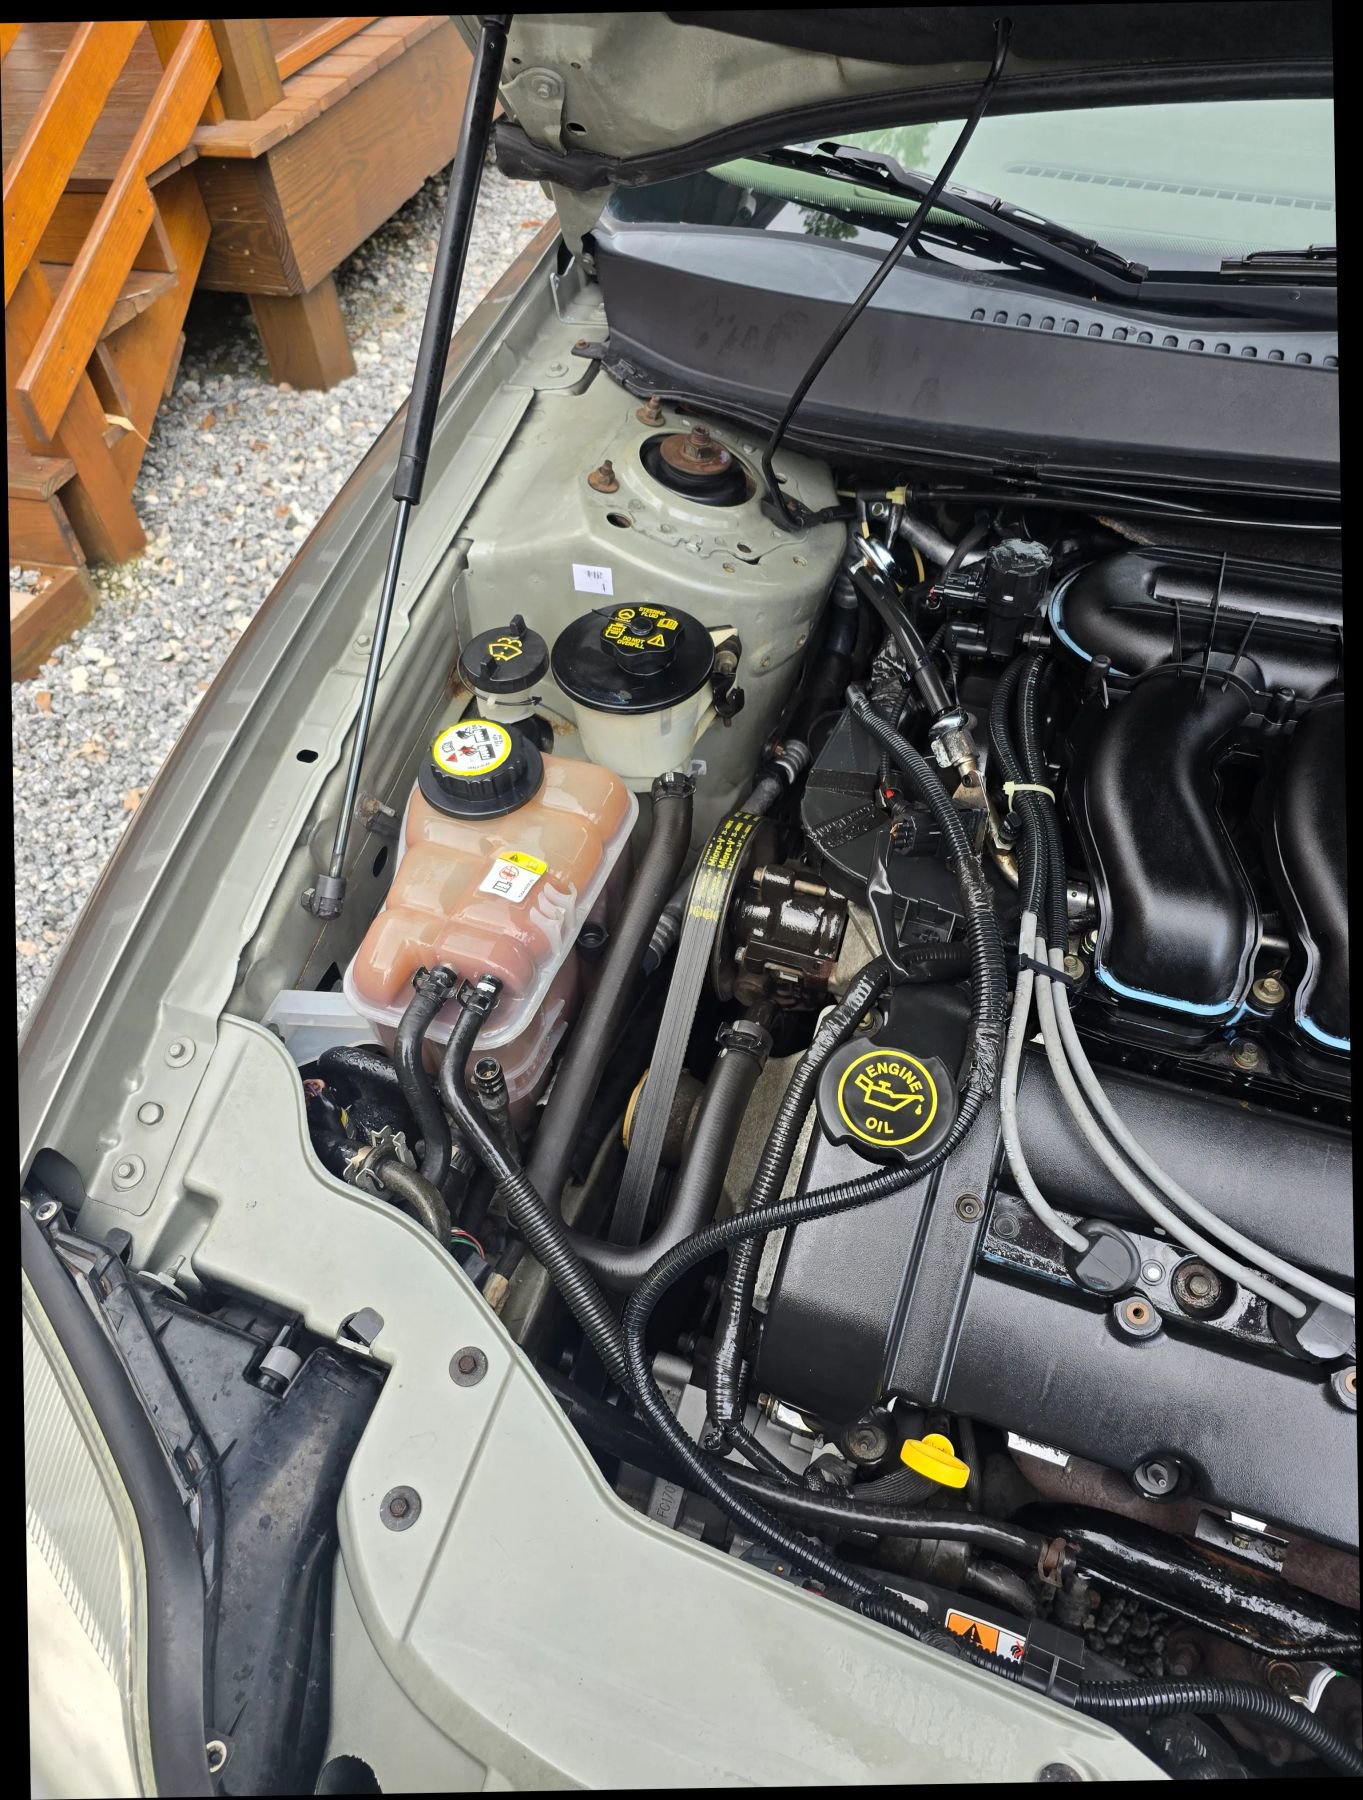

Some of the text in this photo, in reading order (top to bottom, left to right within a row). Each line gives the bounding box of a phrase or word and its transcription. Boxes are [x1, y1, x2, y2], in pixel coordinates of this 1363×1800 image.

[639, 607, 667, 616] STEERING
[617, 640, 645, 650] OVERFILL
[865, 1062, 924, 1093] ENGINE
[865, 1117, 894, 1134] OIL
[656, 1485, 676, 1518] FC170
